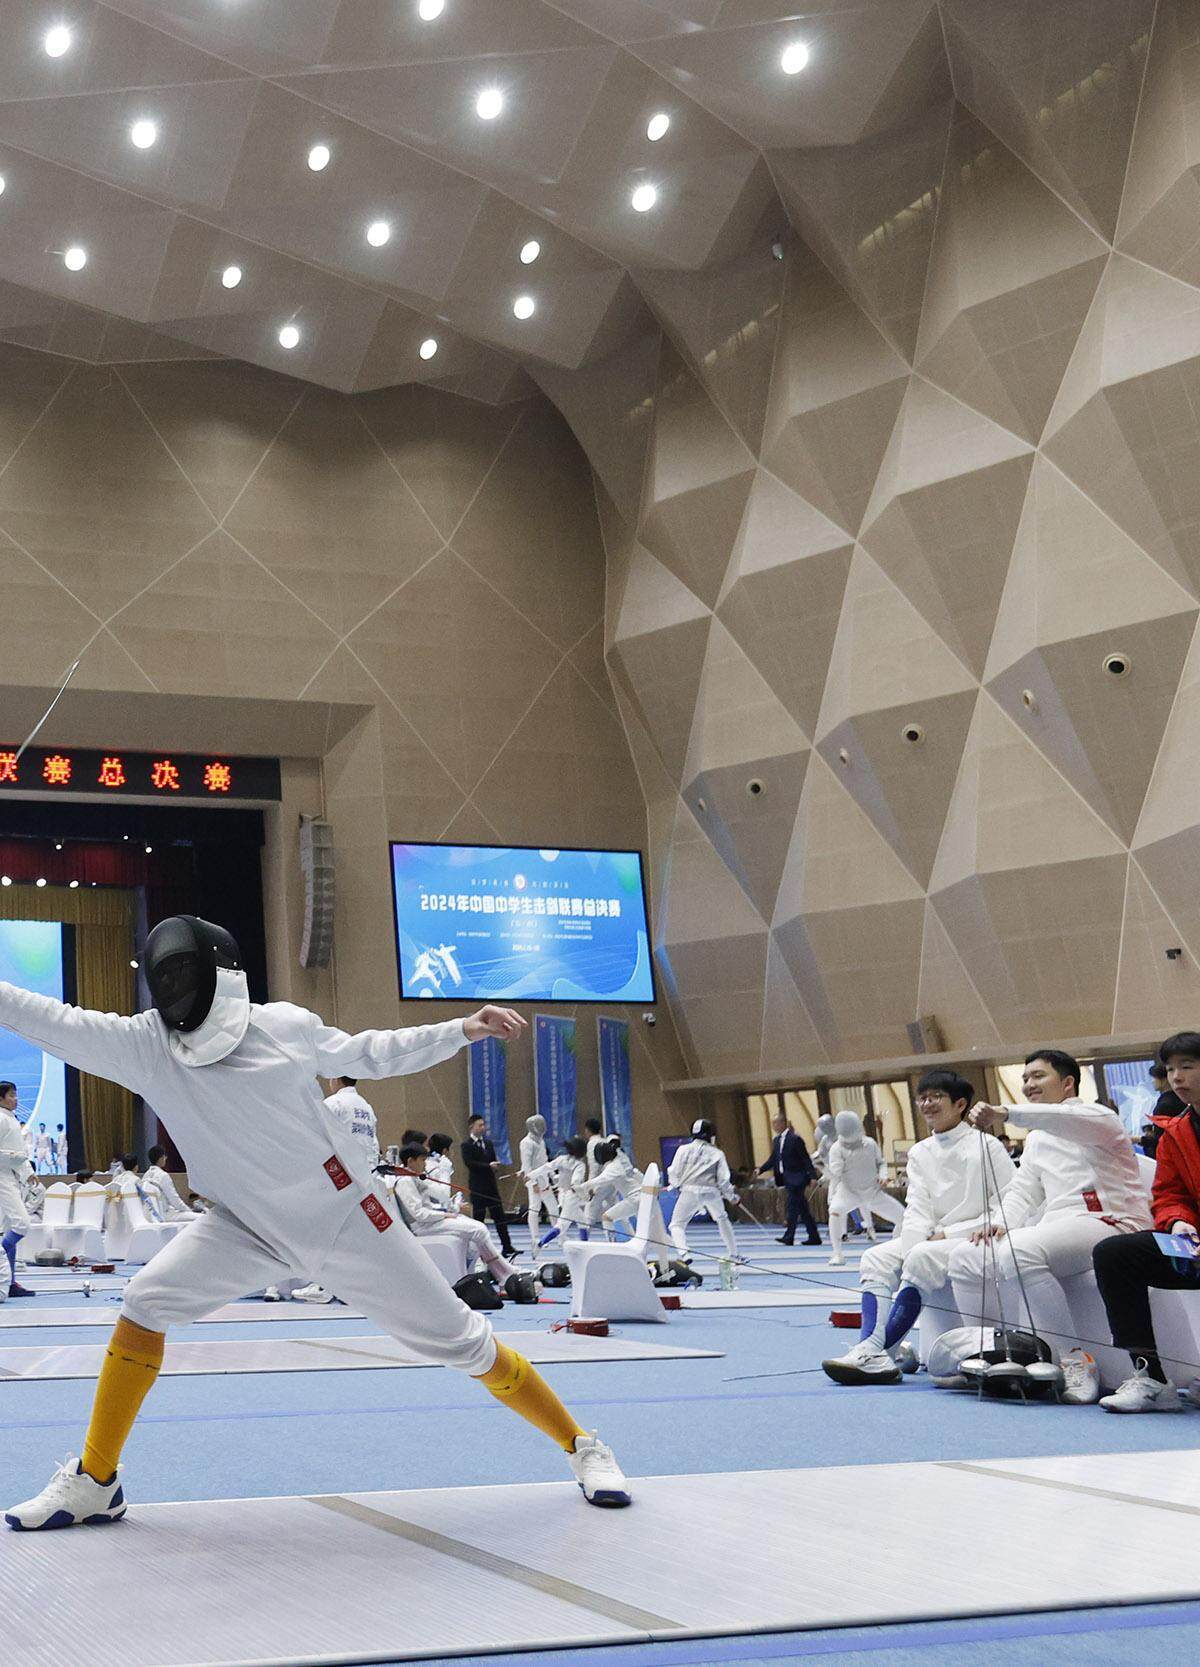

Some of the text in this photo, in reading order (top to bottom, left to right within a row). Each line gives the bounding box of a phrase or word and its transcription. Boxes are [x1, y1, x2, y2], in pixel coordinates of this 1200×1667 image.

[420, 893, 621, 918] 2024年中国中学生击剑联赛总决赛
